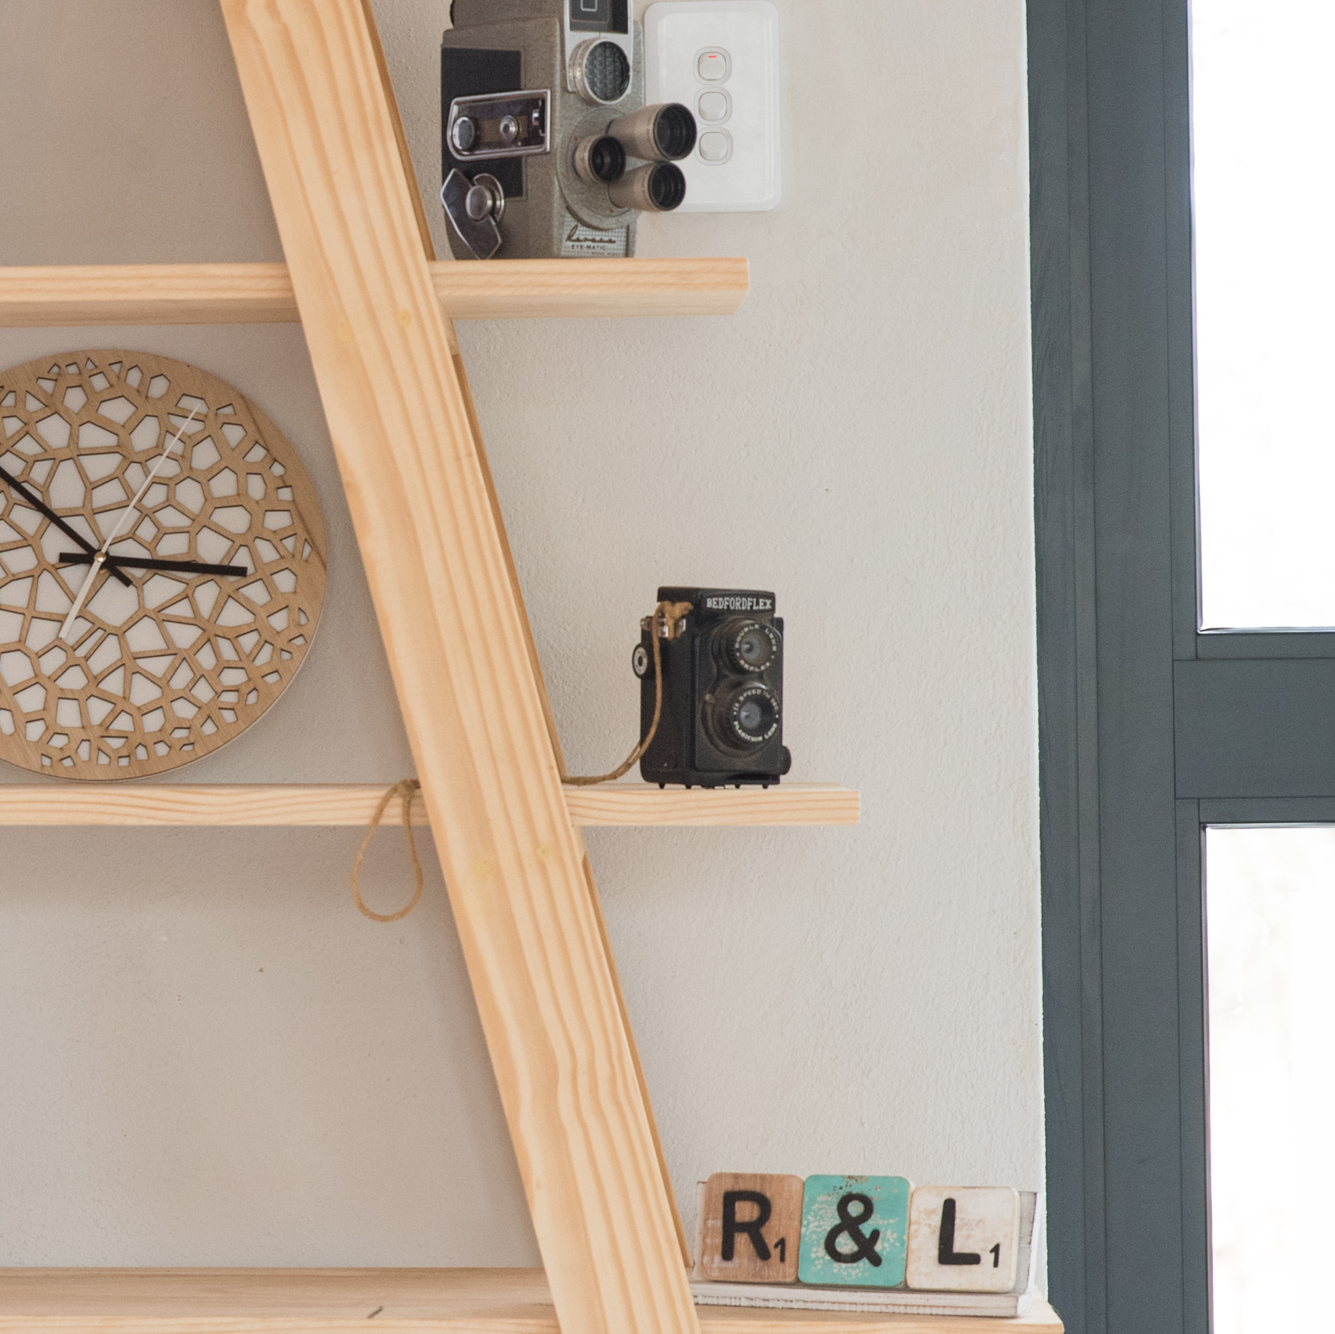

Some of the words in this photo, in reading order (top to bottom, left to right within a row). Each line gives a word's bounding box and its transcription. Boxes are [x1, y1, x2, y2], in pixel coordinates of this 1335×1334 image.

[706, 596, 773, 611] BEDFORDFLEX
[721, 1190, 772, 1262] R
[773, 1237, 786, 1263] 1
[824, 1193, 883, 1268] &
[938, 1197, 981, 1265] L
[989, 1242, 1001, 1269] 1
